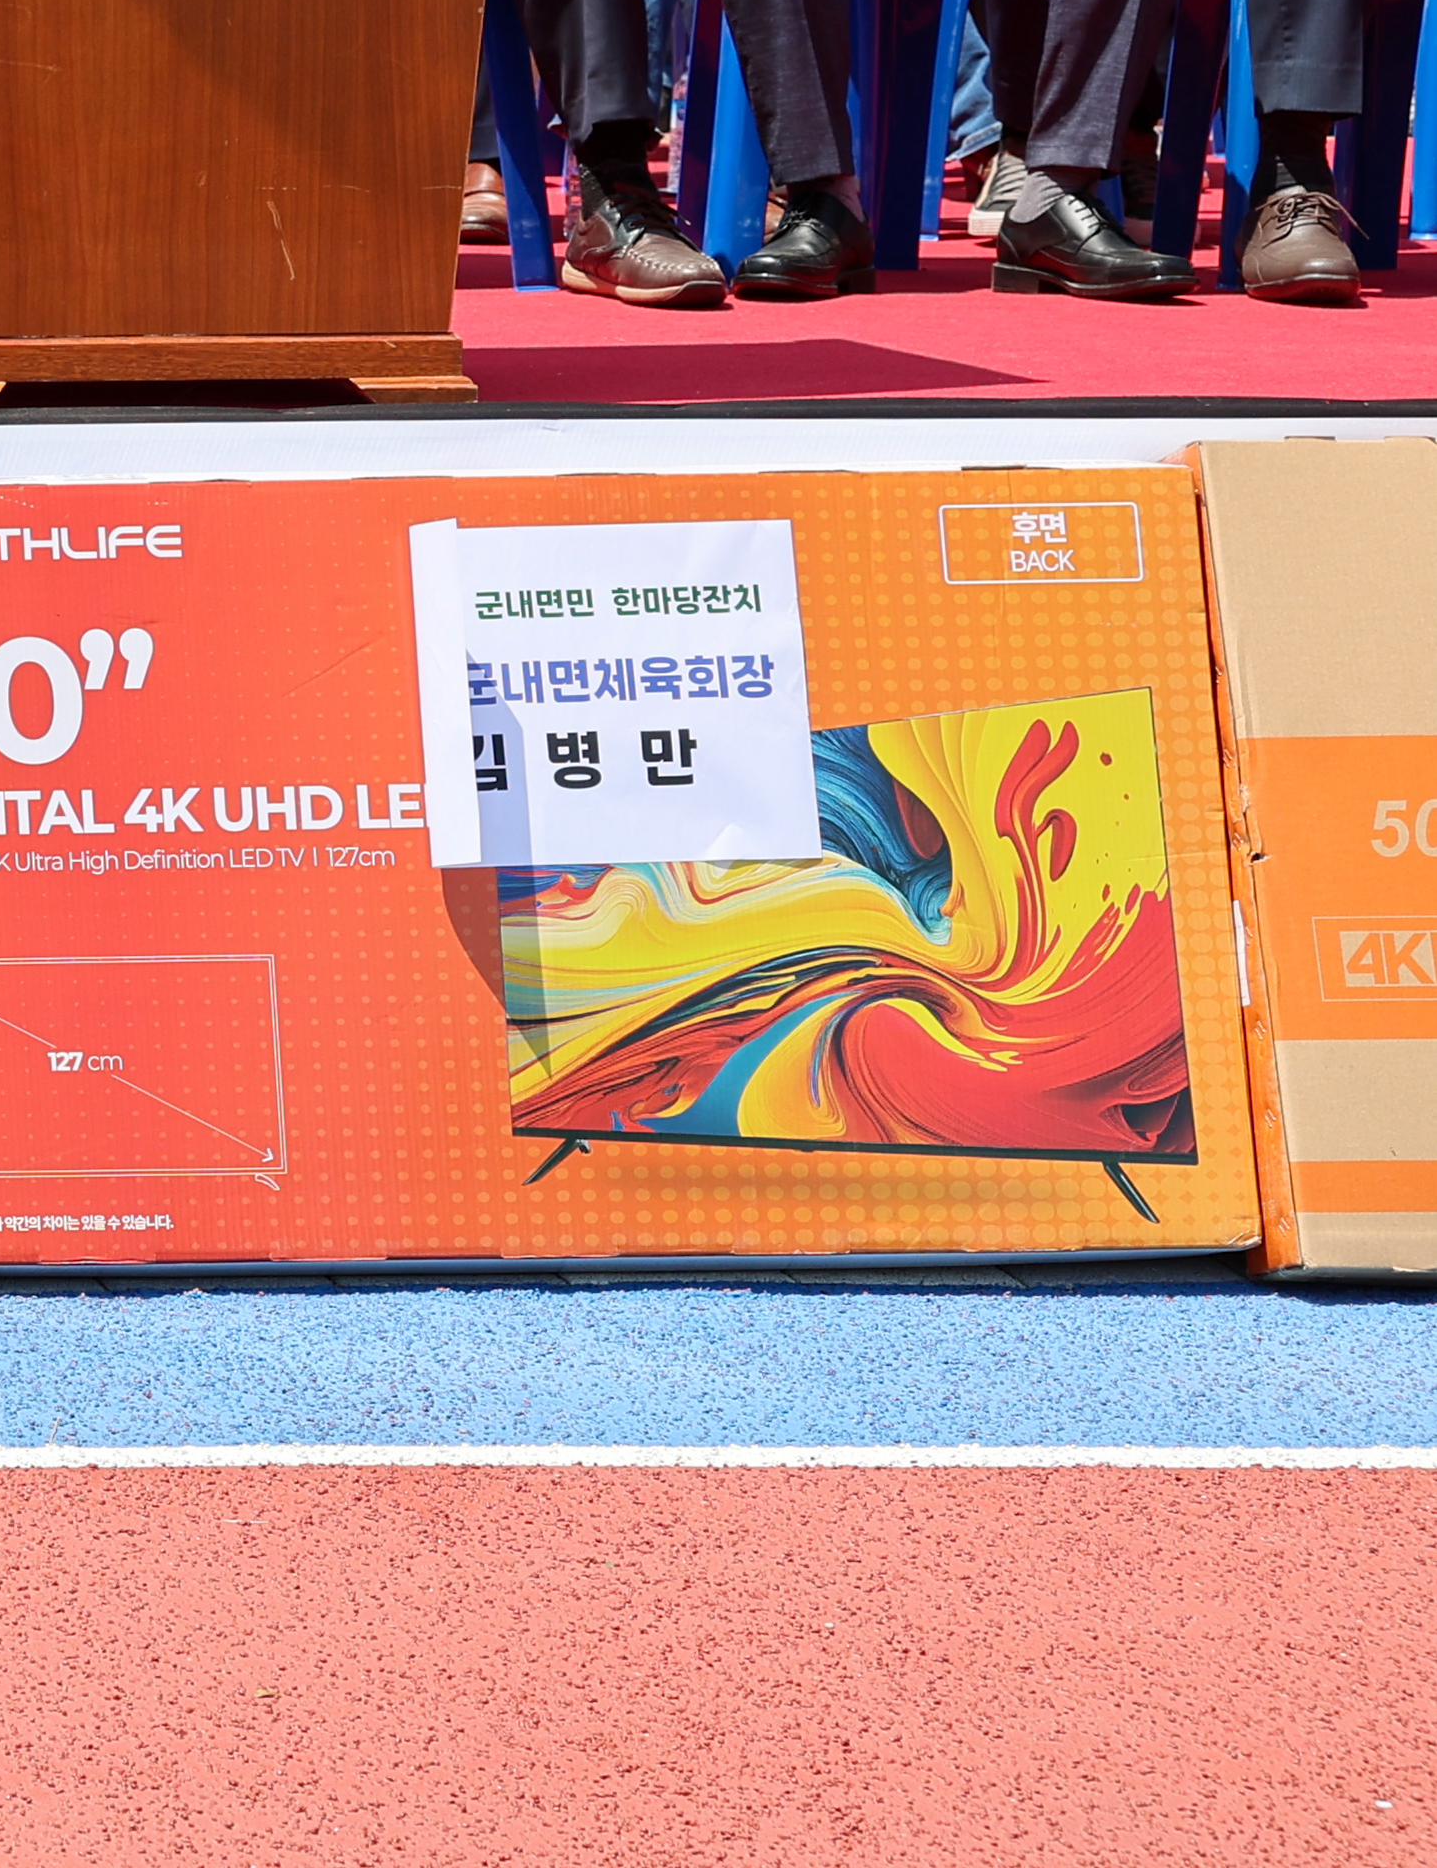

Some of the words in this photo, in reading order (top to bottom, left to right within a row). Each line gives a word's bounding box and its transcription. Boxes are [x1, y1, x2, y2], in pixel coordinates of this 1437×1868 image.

[1012, 511, 1067, 543] 후면
[1010, 550, 1075, 572] BACK
[476, 589, 594, 619] 군내면민
[612, 584, 761, 615] 한마당잔치
[124, 788, 203, 832] 4K
[214, 786, 343, 831] UHD
[357, 783, 426, 829] LE
[15, 852, 63, 871] Ultra
[69, 850, 119, 875] High
[124, 849, 224, 869] Definition
[230, 848, 273, 868] LED
[276, 848, 304, 866] TV
[326, 847, 395, 867] 127cm
[47, 1051, 84, 1072] 127
[87, 1055, 124, 1071] cm
[4, 1216, 41, 1232] 약간의
[42, 1215, 80, 1231] 차이는
[81, 1215, 106, 1231] 있을
[107, 1215, 120, 1230] 수
[122, 1214, 174, 1230] 있습니다.
